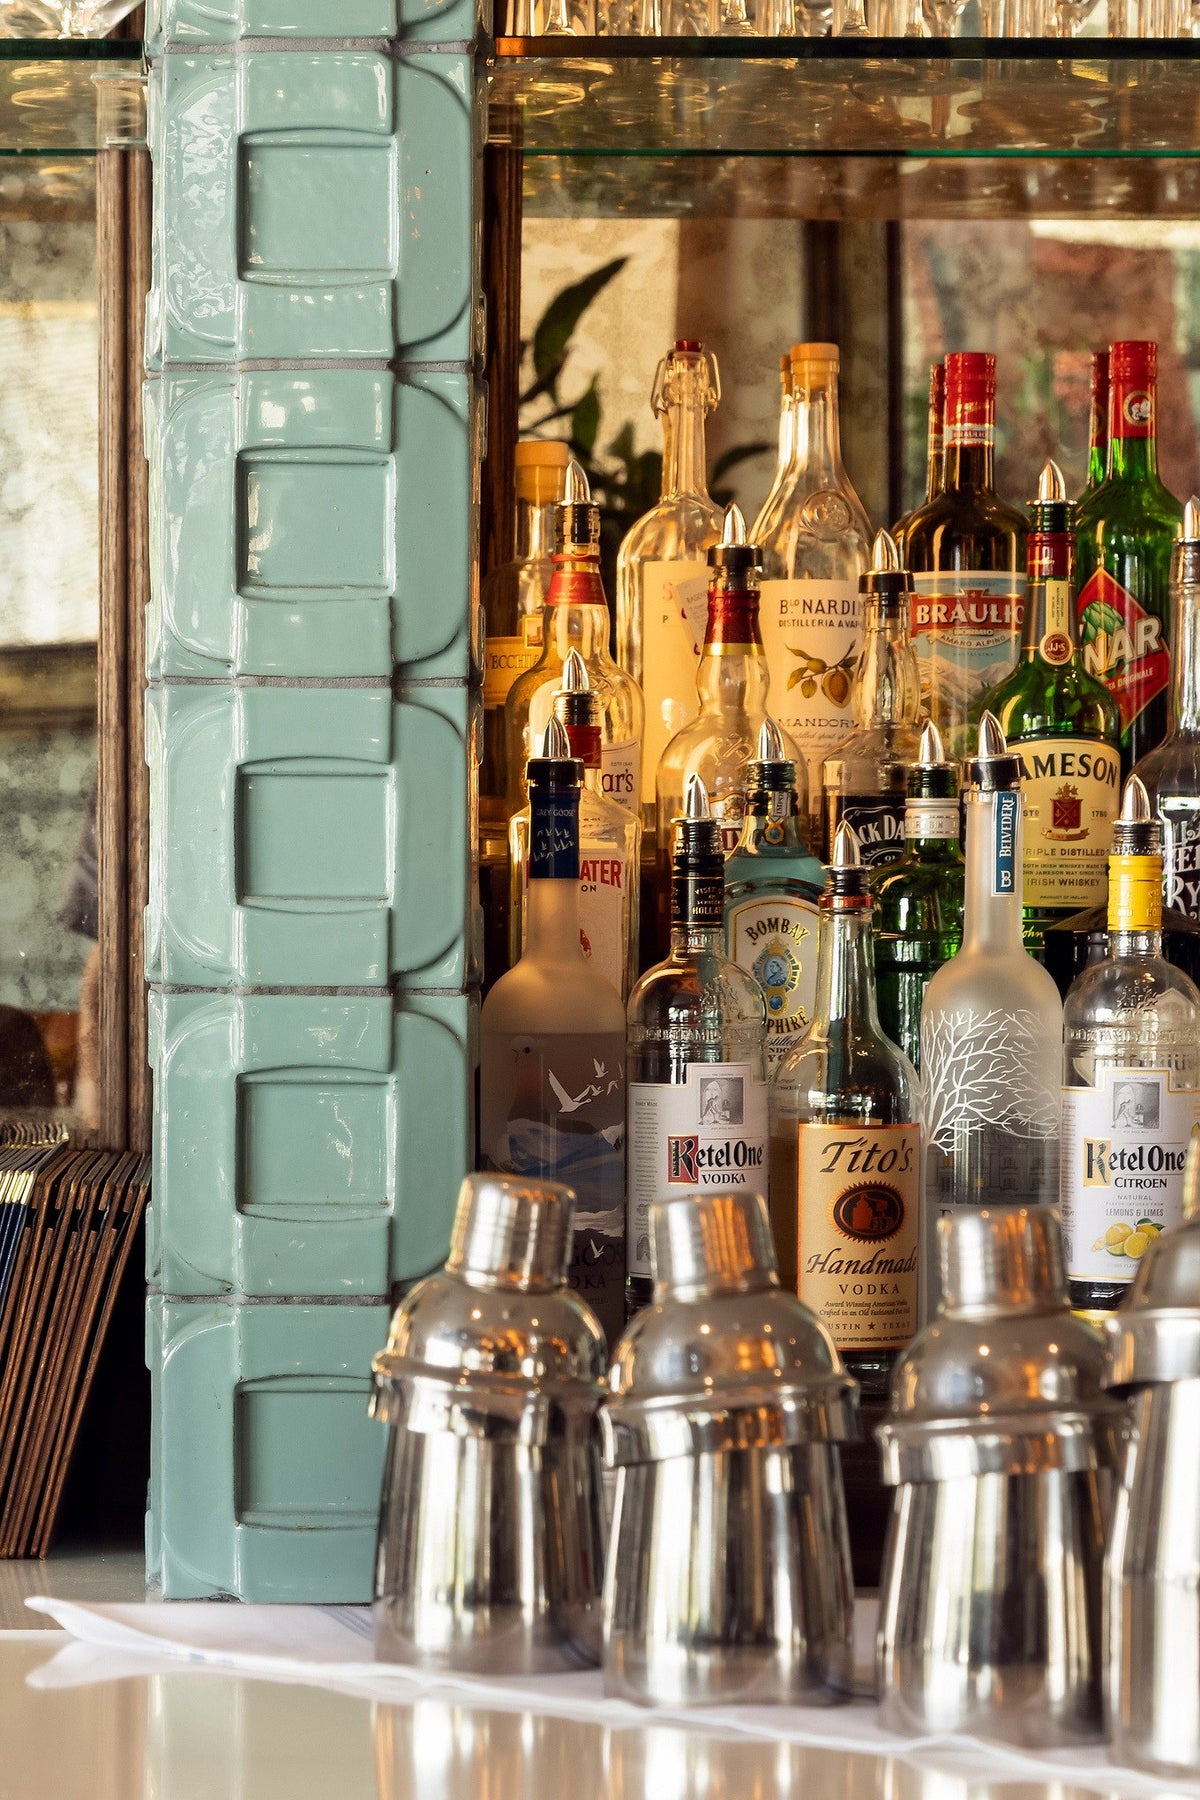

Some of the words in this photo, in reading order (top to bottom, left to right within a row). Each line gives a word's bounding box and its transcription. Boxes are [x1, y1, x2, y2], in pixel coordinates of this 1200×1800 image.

[1080, 615, 1161, 678] NAR
[601, 769, 634, 793] ar's
[1019, 752, 1118, 788] AMESON
[552, 809, 575, 817] GOOSE
[855, 822, 883, 846] CK
[999, 796, 1015, 857] BELVEDERE
[1022, 848, 1057, 857] RIPLE
[1060, 848, 1107, 857] DISTILLED
[580, 859, 622, 889] ATER
[1027, 879, 1056, 887] IRISH
[1059, 879, 1101, 887] WHISKEY
[581, 885, 597, 893] ON
[744, 917, 809, 944] BOMBAY
[766, 1012, 810, 1034] PHIRE
[669, 1138, 732, 1181] Ketel
[733, 1140, 764, 1168] One
[819, 1136, 912, 1173] Tito's
[1086, 1142, 1145, 1182] Ketel
[1147, 1145, 1184, 1172] One
[701, 1173, 746, 1184] VODKA
[1114, 1177, 1168, 1190] CITROEN
[1105, 1208, 1134, 1217] LEMONS
[1143, 1208, 1164, 1217] LIMES
[838, 1284, 900, 1296] VODKA
